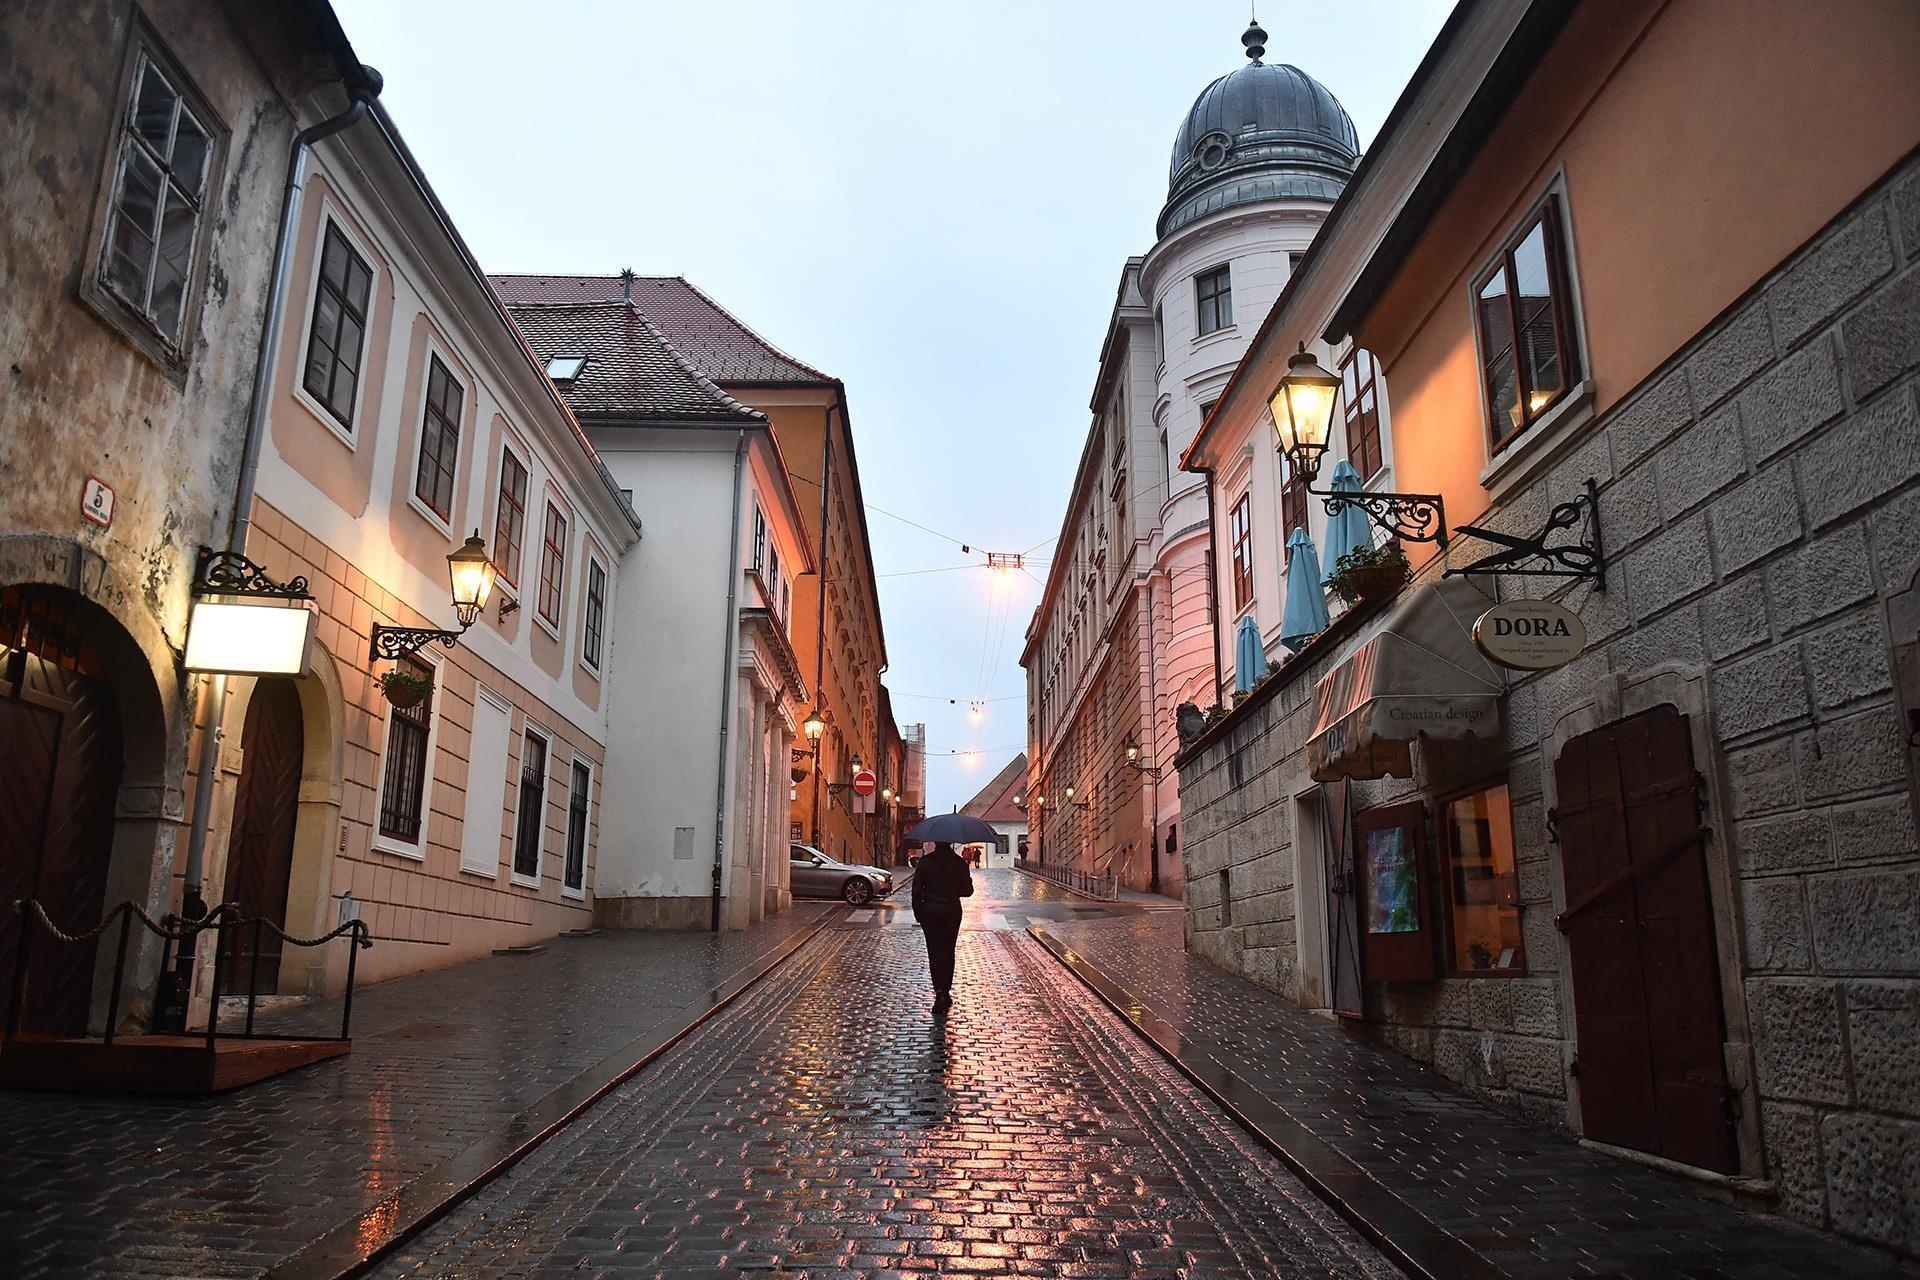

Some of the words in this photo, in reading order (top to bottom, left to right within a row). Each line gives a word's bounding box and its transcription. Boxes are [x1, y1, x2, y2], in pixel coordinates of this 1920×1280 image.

[94, 484, 105, 508] 5
[1493, 617, 1571, 637] DORA
[1390, 707, 1441, 721] Croatian
[1446, 706, 1484, 722] design
